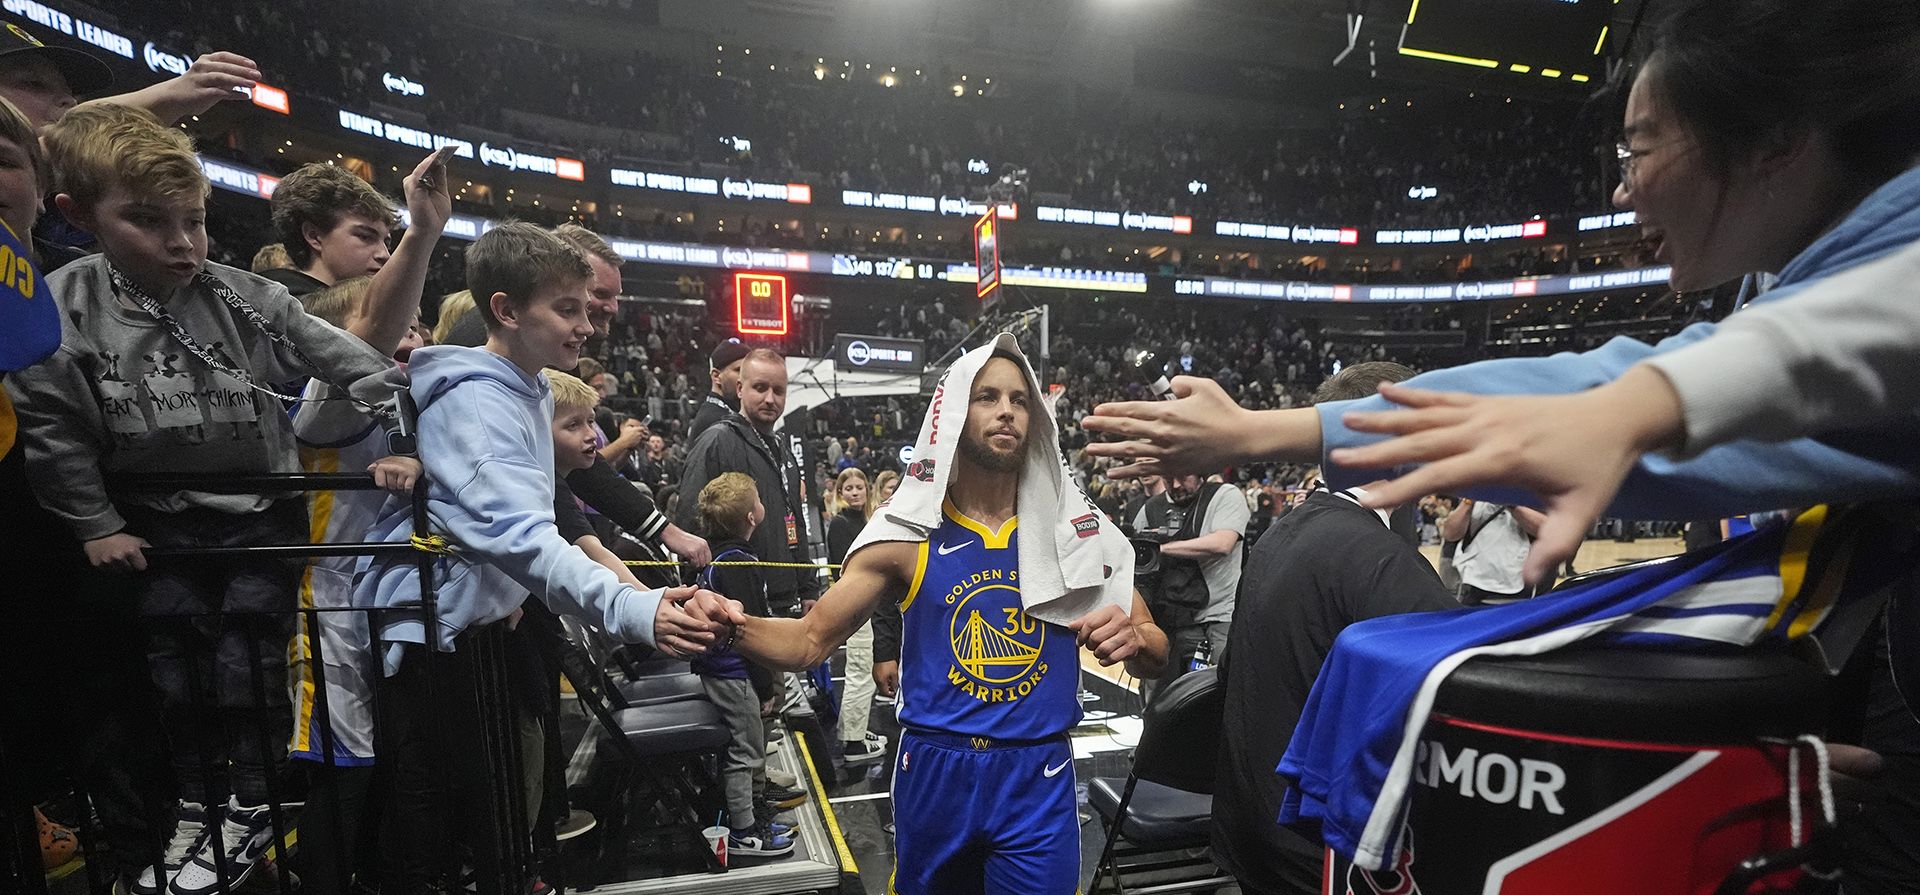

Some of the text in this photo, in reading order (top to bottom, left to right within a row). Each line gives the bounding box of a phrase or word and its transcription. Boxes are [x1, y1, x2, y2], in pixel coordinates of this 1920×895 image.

[1, 0, 73, 36] SPORTS
[75, 18, 134, 59] LEADER
[204, 161, 259, 194] SPORTS
[751, 281, 771, 297] 0.0
[104, 388, 253, 420] EAT MOR CHIKIN
[945, 569, 1002, 605] GOLDEN
[1002, 607, 1036, 636] 30
[947, 661, 1049, 703] WARRIORS
